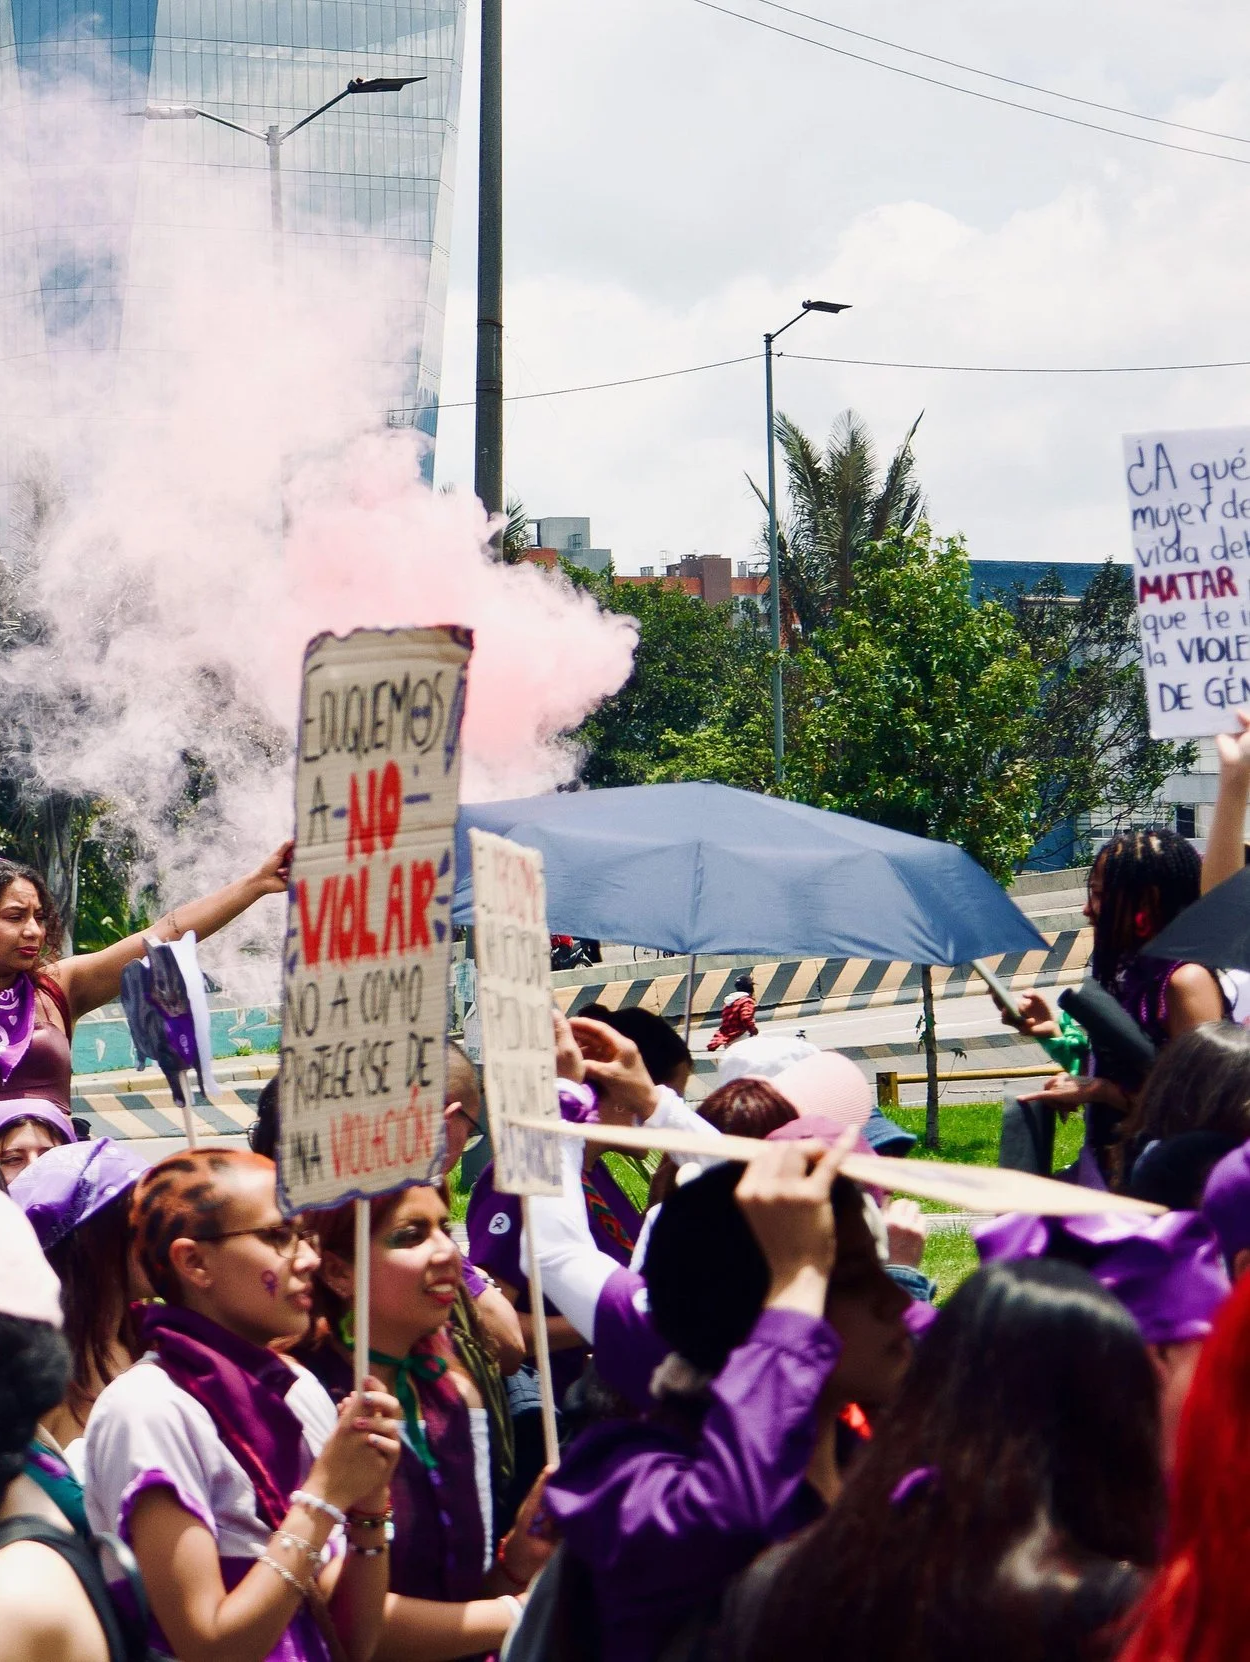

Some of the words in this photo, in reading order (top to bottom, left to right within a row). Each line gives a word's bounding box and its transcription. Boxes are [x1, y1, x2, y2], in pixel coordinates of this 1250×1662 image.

[1190, 447, 1250, 505] qué
[1132, 498, 1212, 547] mujer
[1135, 527, 1200, 567] vida
[1139, 565, 1238, 604] MATAR
[1143, 611, 1187, 644] que
[1201, 601, 1230, 630] te
[1145, 641, 1167, 668] la
[1158, 682, 1194, 712] DE
[308, 775, 330, 846] A
[347, 760, 403, 860] NO
[296, 860, 437, 972] VIOLAR
[285, 981, 321, 1038] NO
[329, 976, 349, 1029] A
[360, 963, 423, 1026] COMO
[406, 1031, 435, 1088] DE
